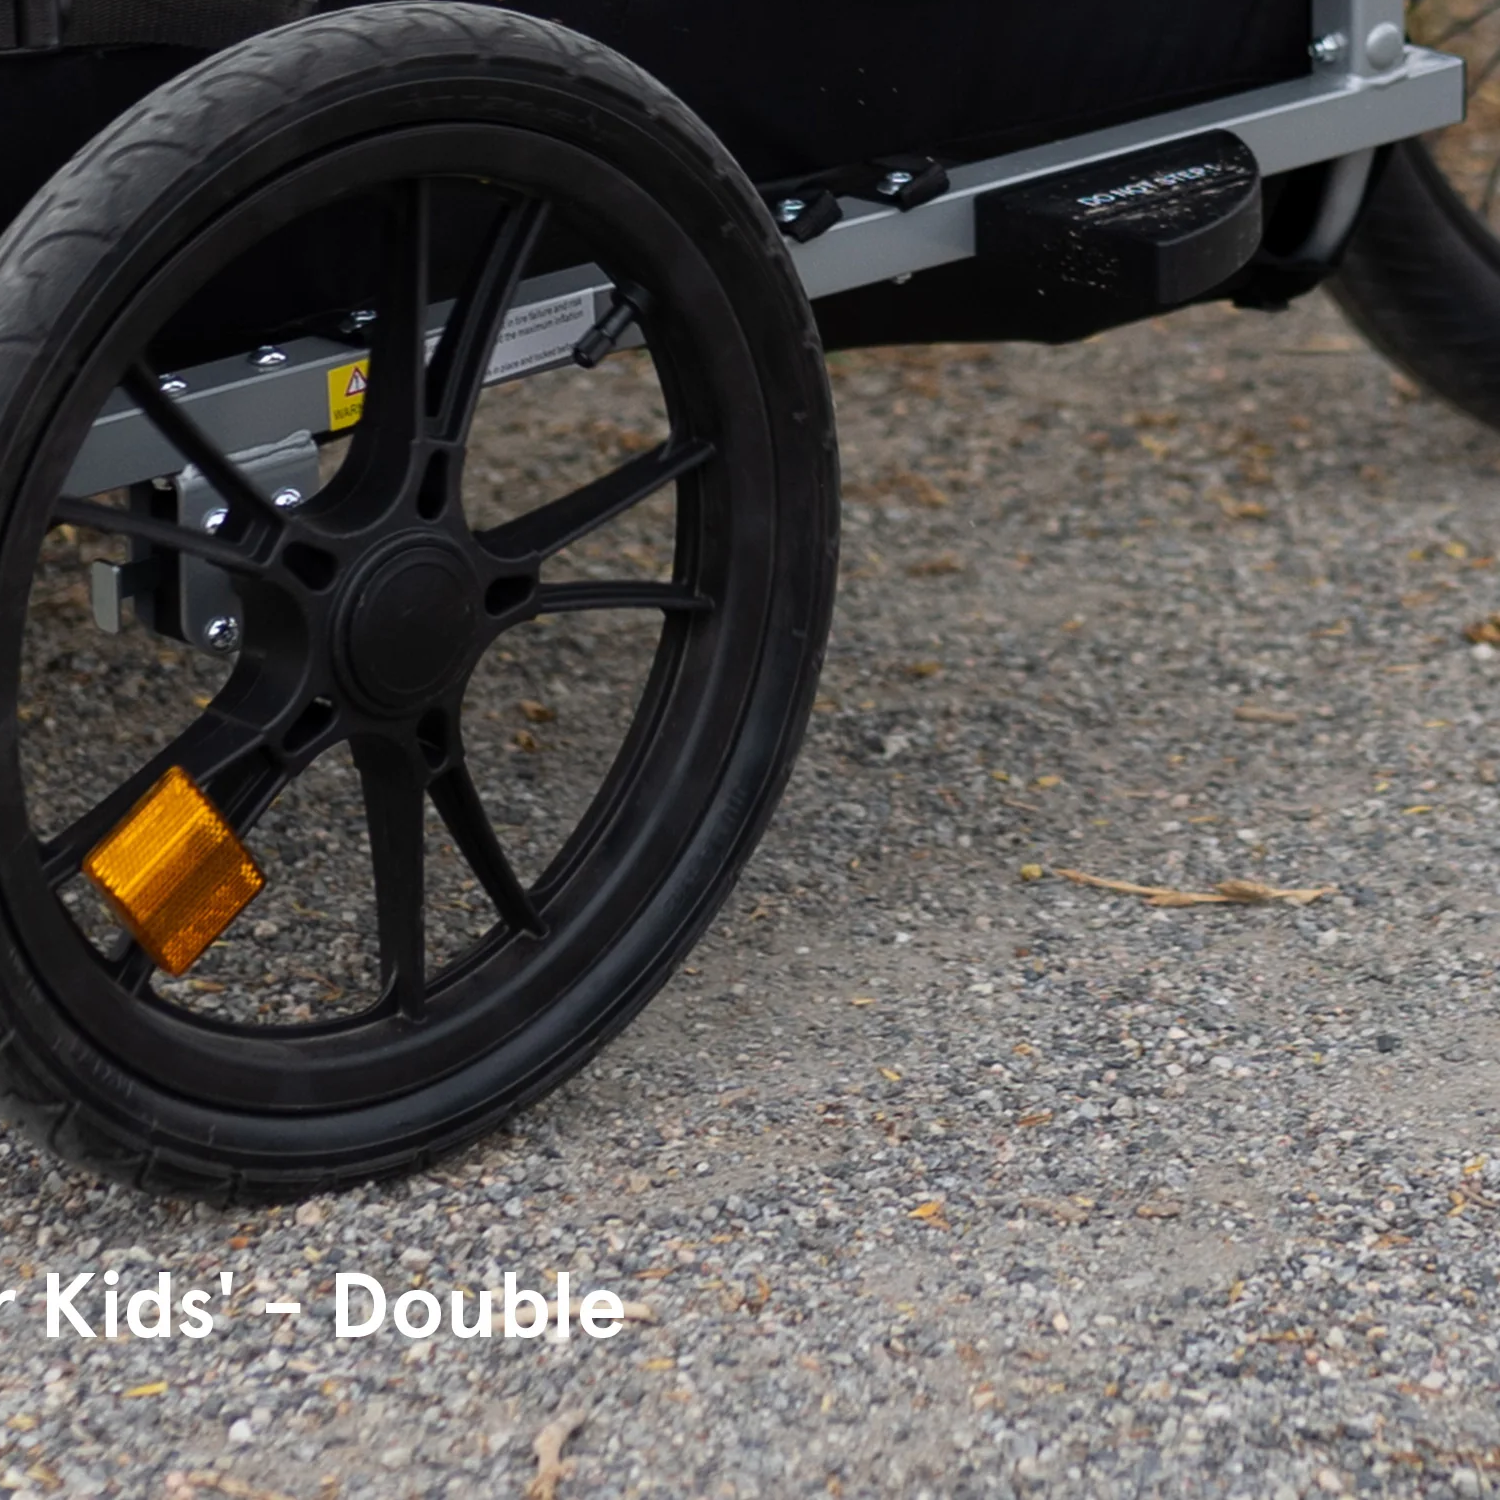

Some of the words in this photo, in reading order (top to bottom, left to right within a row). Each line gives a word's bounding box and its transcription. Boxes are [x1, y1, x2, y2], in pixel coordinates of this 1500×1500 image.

[1076, 192, 1116, 207] DO
[1109, 180, 1159, 198] NOT
[554, 302, 568, 313] and
[518, 320, 553, 336] maximum
[554, 309, 584, 325] inflation
